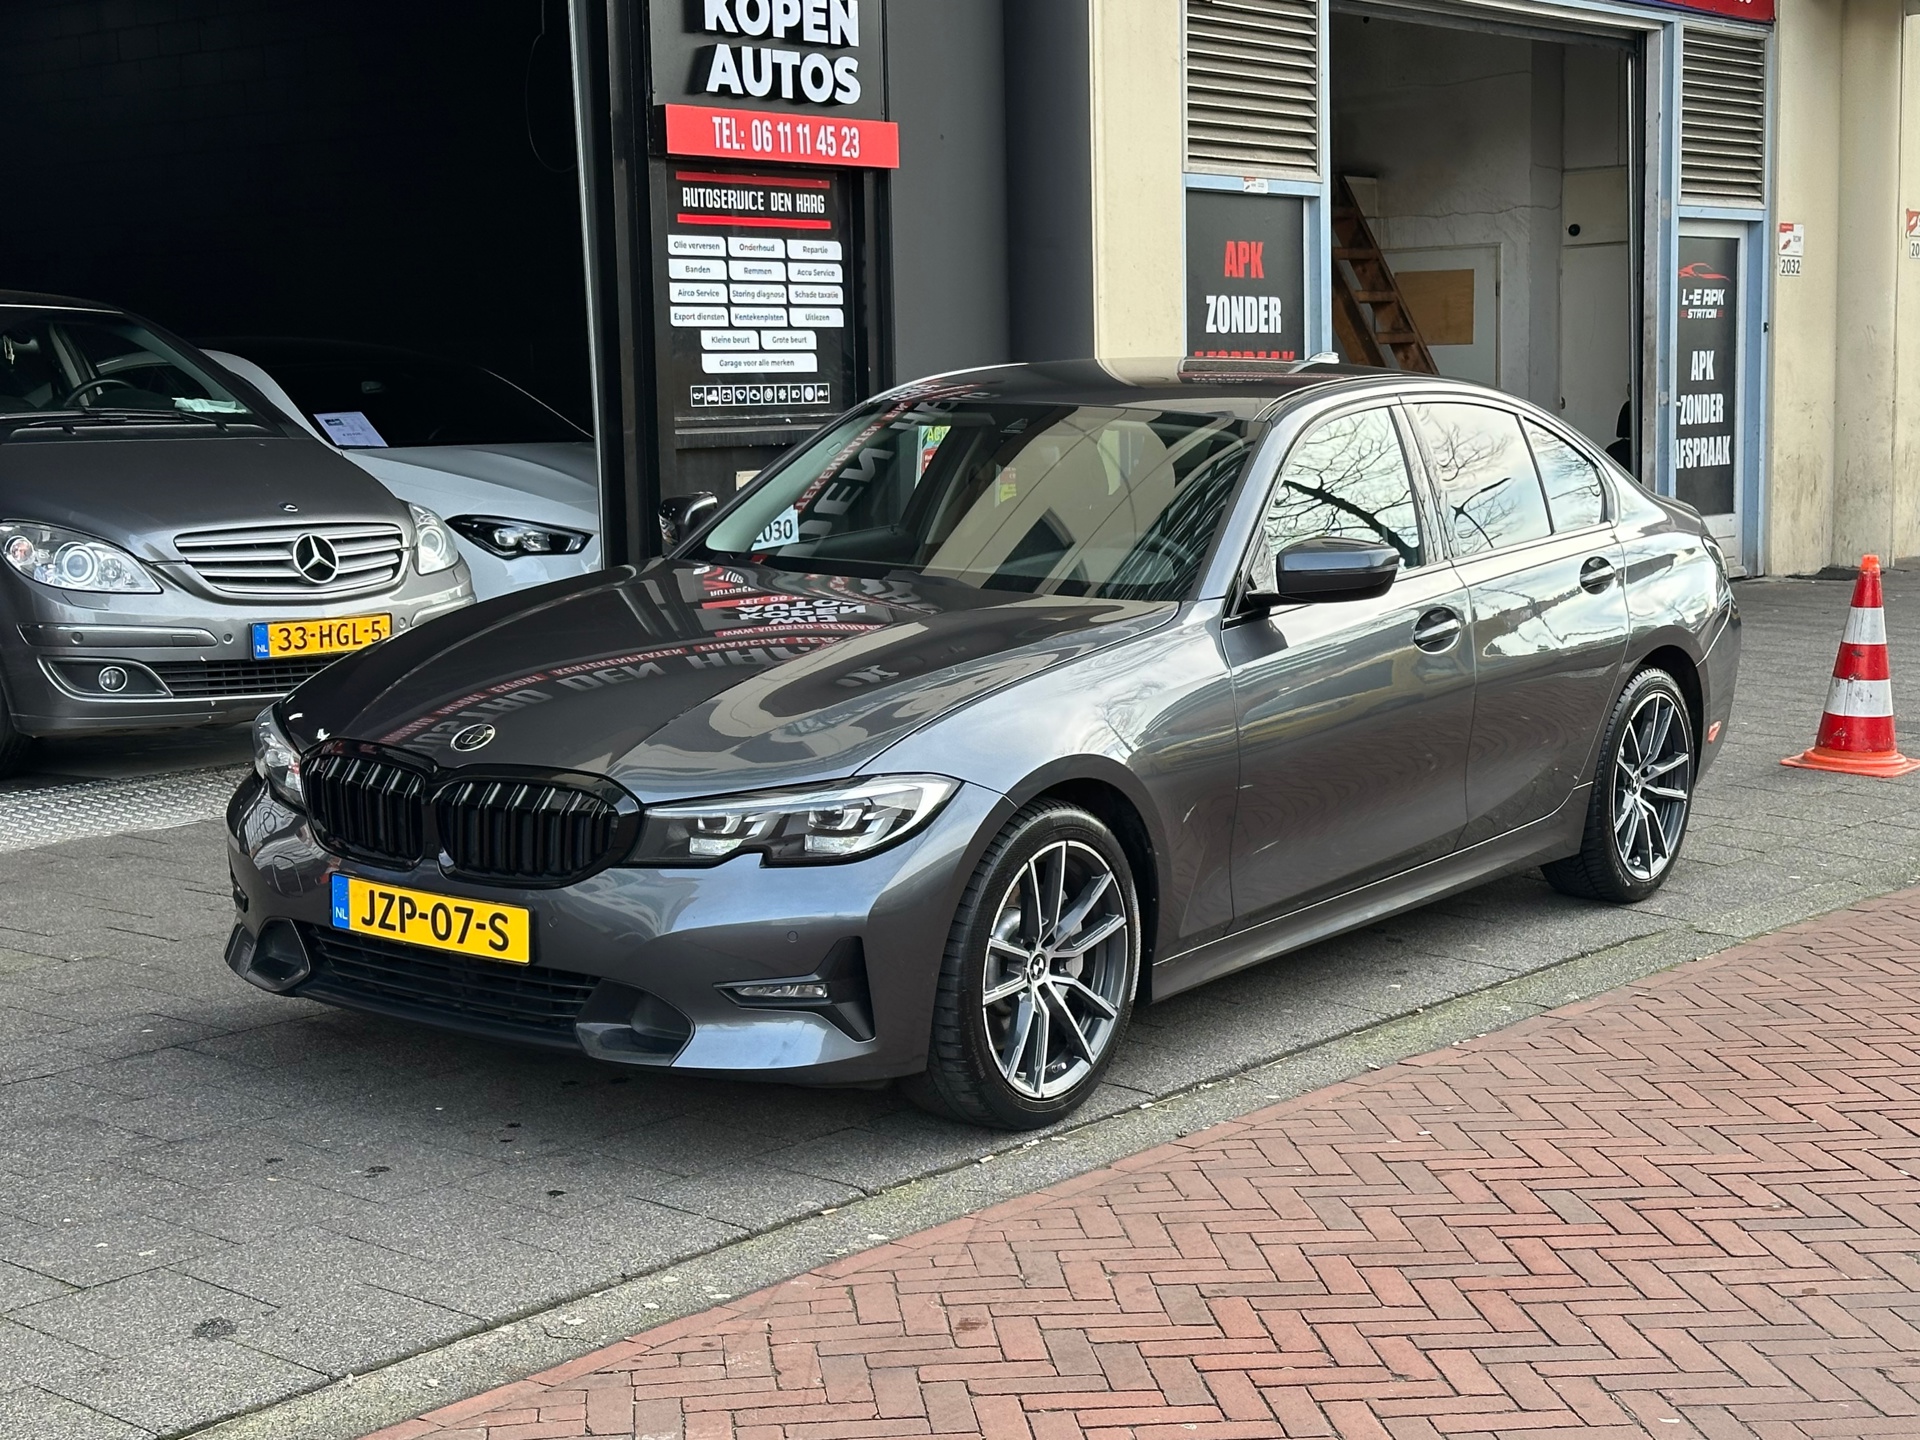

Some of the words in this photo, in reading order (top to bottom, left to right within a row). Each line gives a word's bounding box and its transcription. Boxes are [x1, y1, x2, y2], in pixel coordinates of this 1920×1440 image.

[704, 0, 859, 47] KOPEN
[705, 43, 861, 104] AUTOS
[712, 116, 745, 150] TEL:
[751, 119, 773, 153] 06
[777, 121, 792, 154] 11
[797, 123, 811, 155] 11
[816, 125, 836, 158] 45
[841, 126, 860, 159] 23
[682, 187, 765, 211] AUTOSERVICE
[770, 192, 792, 213] DEN
[796, 194, 825, 214] HAAG
[673, 241, 687, 249] Olie
[688, 242, 720, 250] verversen
[739, 243, 775, 252] Onderhoud
[1224, 240, 1265, 279] APK
[685, 265, 711, 274] Banden
[743, 266, 772, 275] Remmen
[1781, 259, 1801, 274] 2032
[797, 268, 812, 276] Accu
[813, 269, 835, 277] Service
[677, 288, 695, 297] Airco
[696, 289, 720, 297] Service
[732, 289, 756, 299] Storing
[756, 290, 785, 299] diagnose
[794, 290, 817, 299] Schade
[1681, 288, 1703, 306] L-E
[1702, 288, 1726, 306] APK
[674, 312, 695, 322] Export
[697, 312, 725, 320] diensten
[734, 313, 784, 322] Kentekenplaten
[805, 313, 830, 321] Uitlezen
[1205, 295, 1282, 334] ZONDER
[1687, 308, 1718, 319] STATION
[711, 335, 731, 344] Kleine
[732, 335, 750, 344] beurt
[772, 336, 789, 344] Grote
[790, 336, 807, 344] beurt
[719, 359, 742, 368] Garage
[758, 358, 770, 367] alle
[771, 359, 795, 367] merken
[1690, 350, 1715, 381] APK
[1680, 393, 1724, 425] ZONDER
[754, 519, 793, 544] 030
[257, 645, 268, 653] NL
[278, 621, 382, 652] 33-HGL-5
[335, 907, 348, 920] NL
[361, 890, 509, 951] JZP-07-S
